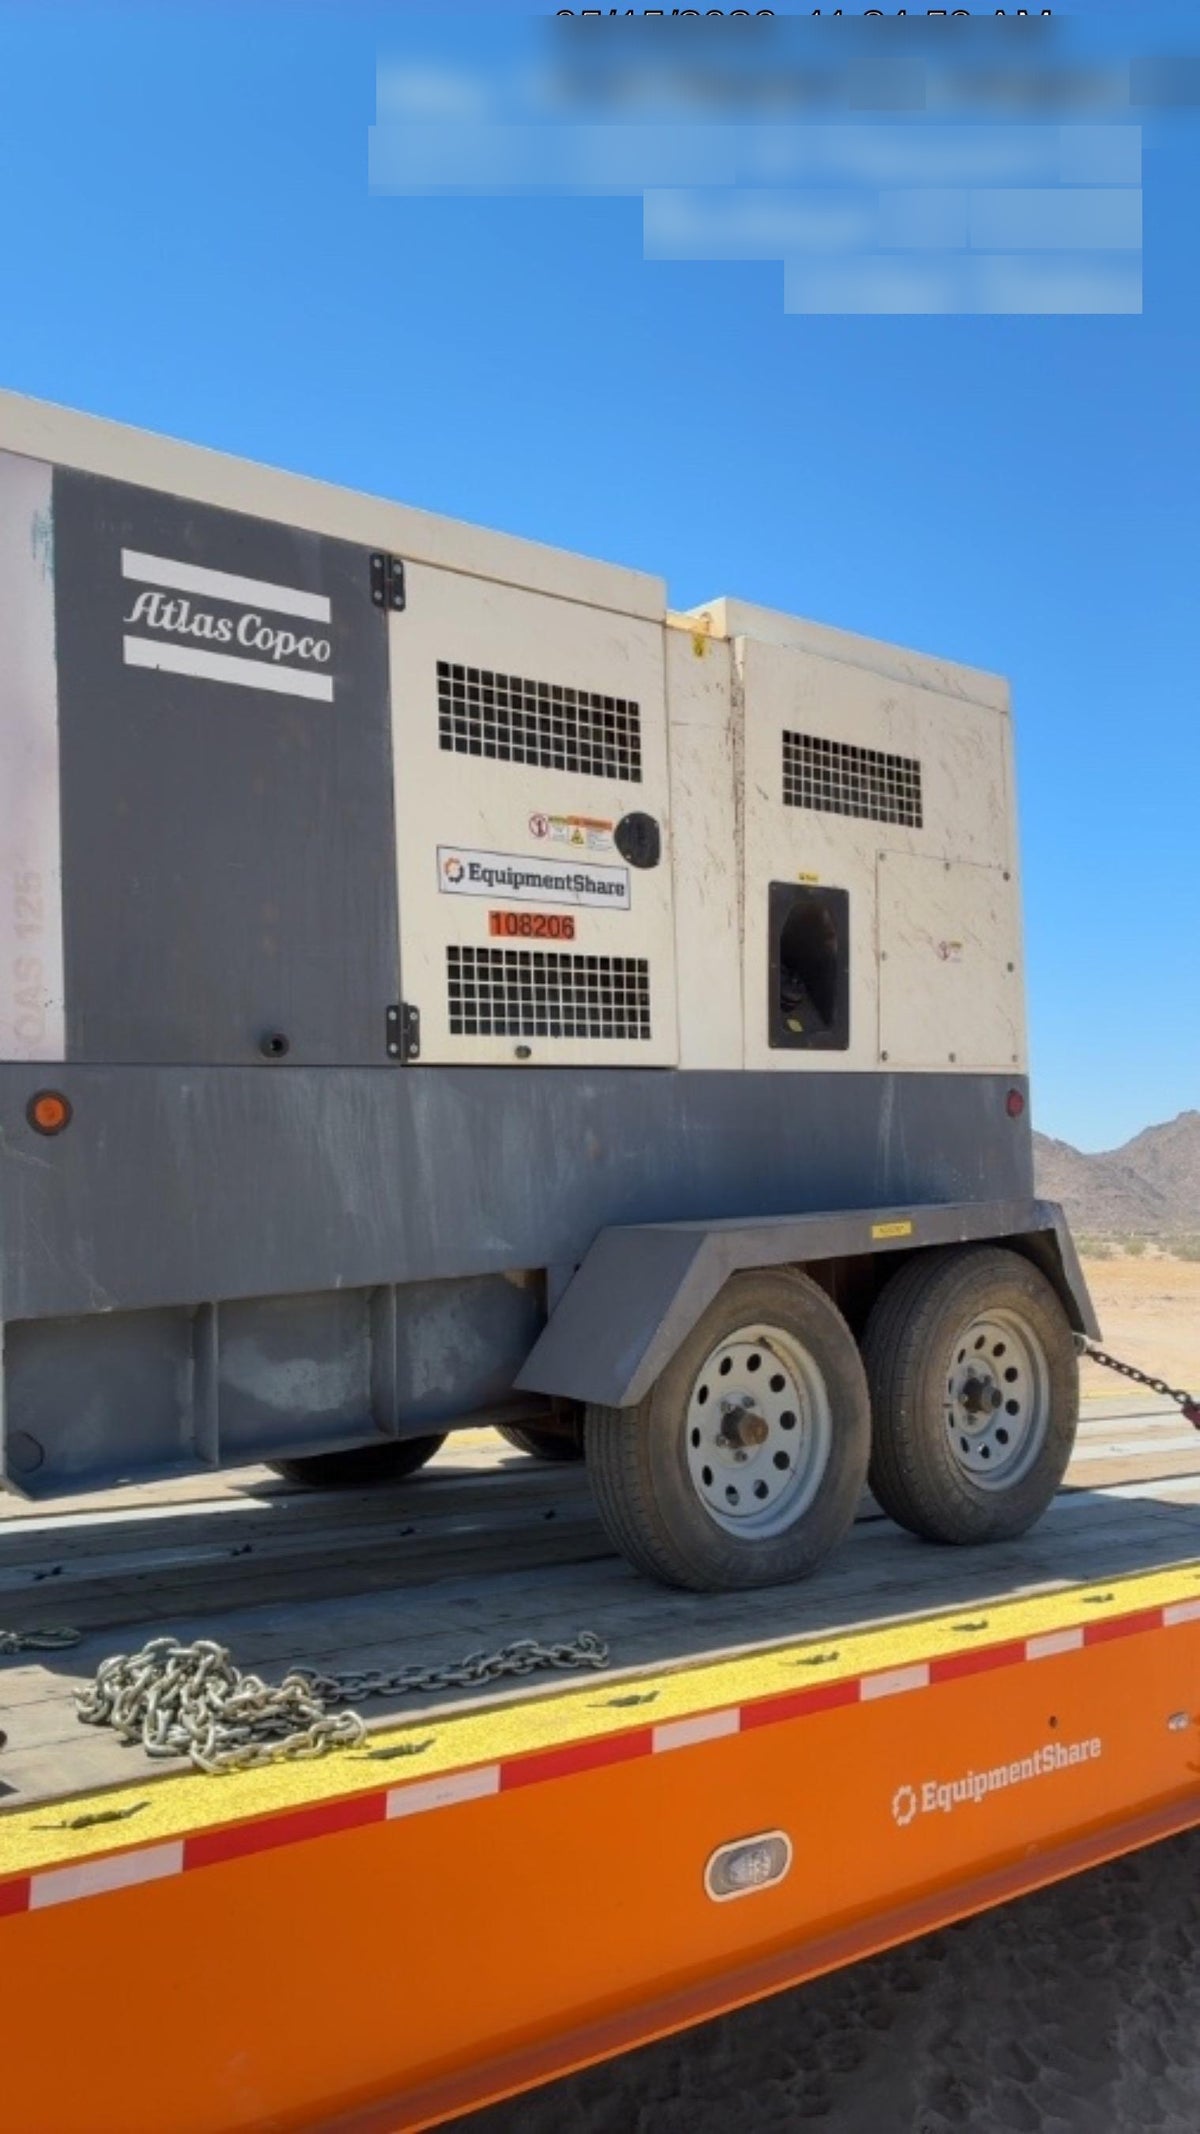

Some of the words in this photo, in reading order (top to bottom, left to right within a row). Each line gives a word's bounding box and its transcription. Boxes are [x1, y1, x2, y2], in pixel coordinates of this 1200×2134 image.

[123, 591, 233, 642] Atlas
[236, 613, 331, 662] Copco
[13, 871, 44, 942] 125
[467, 862, 625, 896] EquipmentShare
[490, 912, 575, 940] 108206
[921, 1736, 1102, 1812] EquipmentShare
